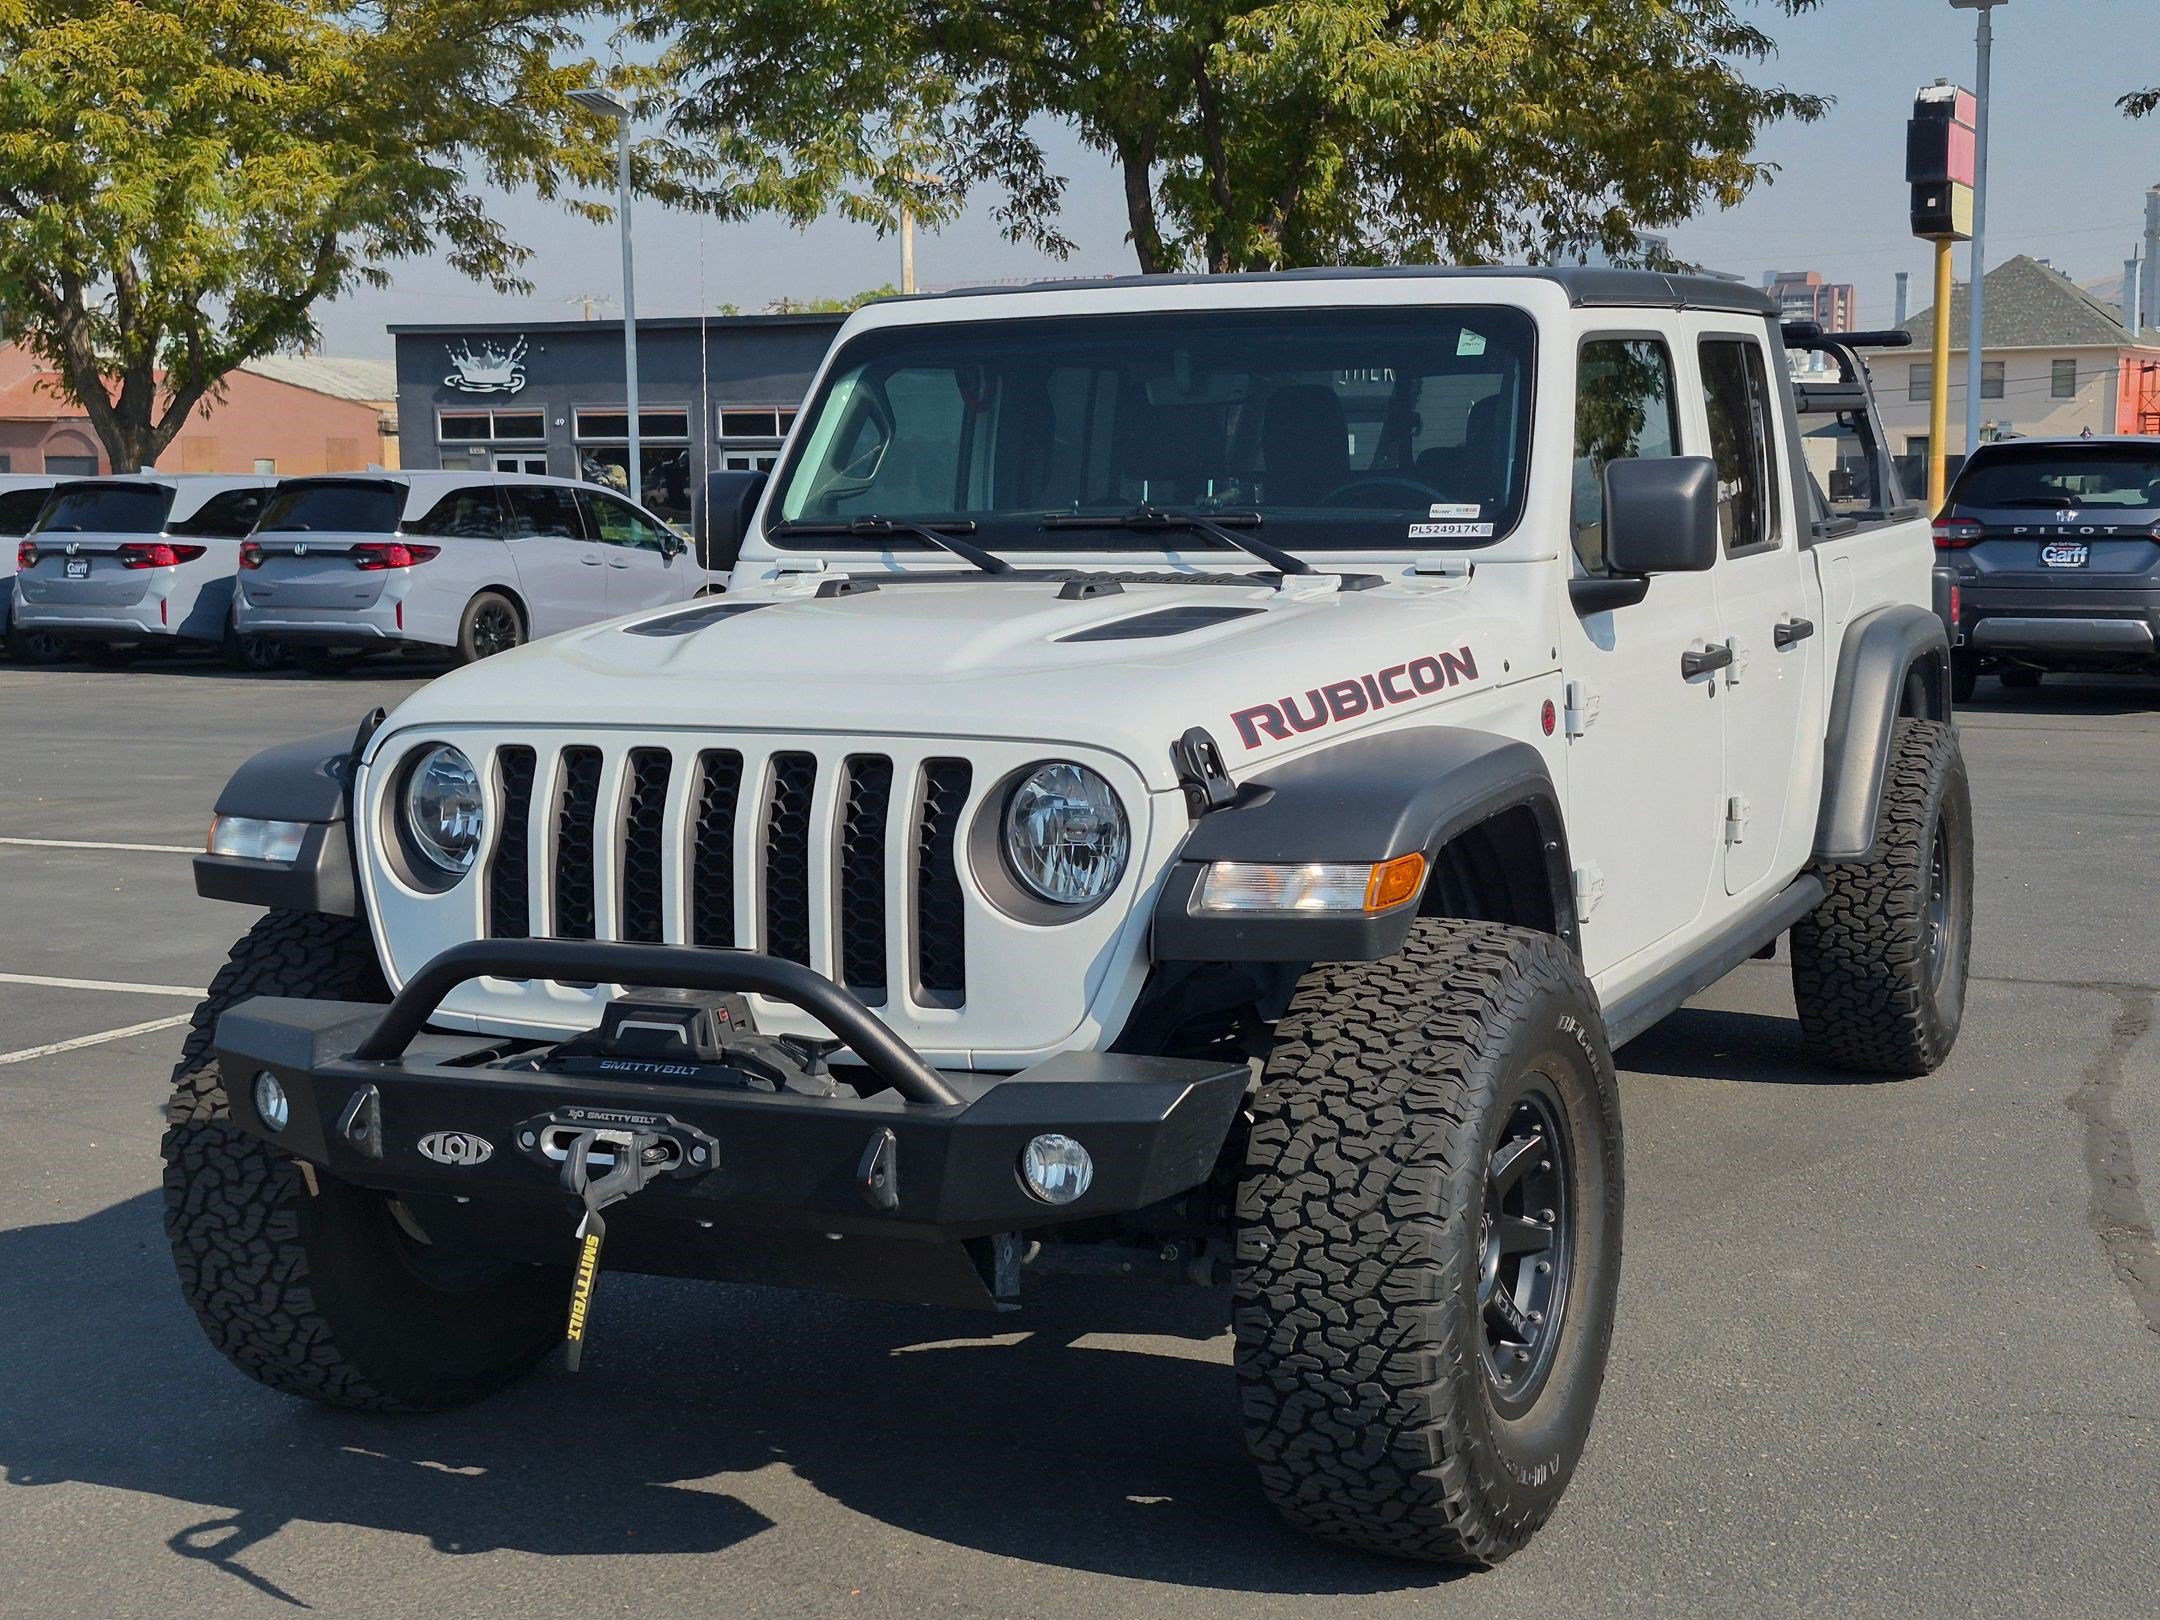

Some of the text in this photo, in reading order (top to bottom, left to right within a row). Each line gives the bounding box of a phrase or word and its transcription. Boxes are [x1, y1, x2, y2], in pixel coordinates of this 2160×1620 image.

[555, 418, 565, 427] 49
[1410, 524, 1479, 534] PL524917K
[2013, 526, 2118, 534] PILOT
[2041, 546, 2088, 563] Garff
[1230, 646, 1479, 750] RUBICON
[600, 1060, 700, 1076] SMITTYBILT
[587, 1111, 657, 1124] SMITTYBILT
